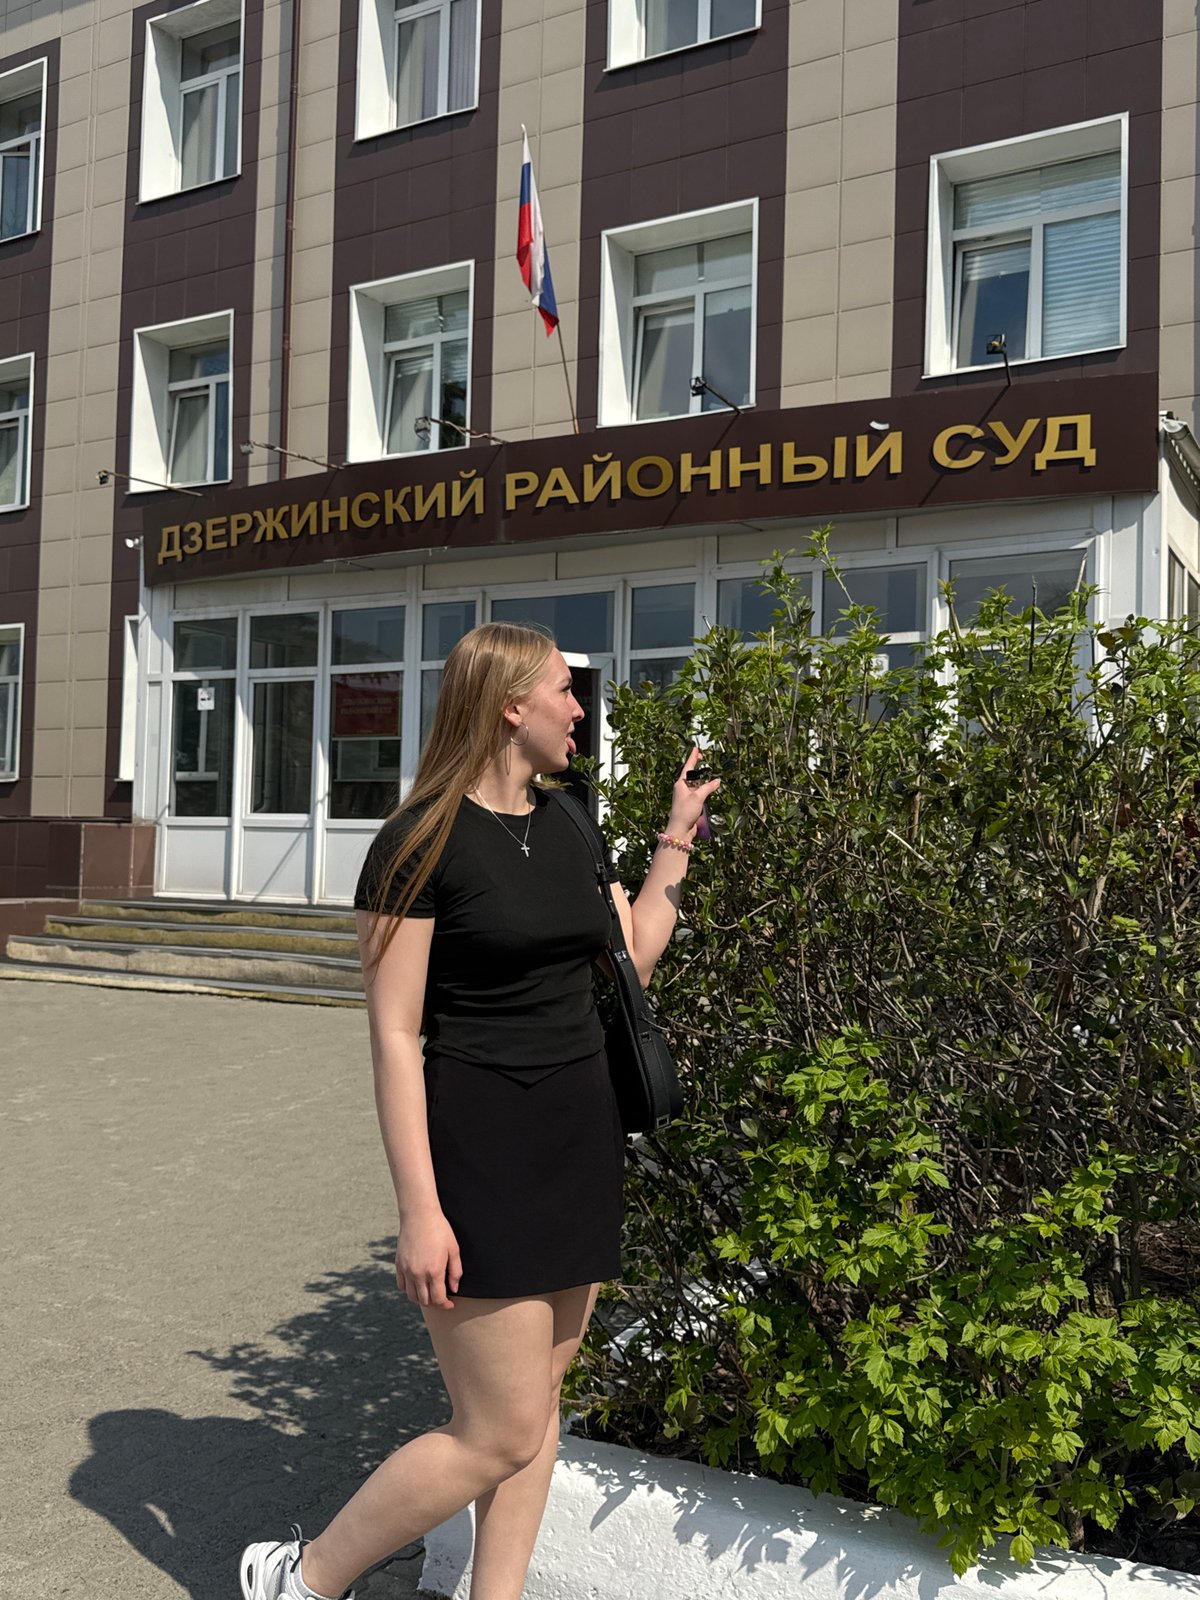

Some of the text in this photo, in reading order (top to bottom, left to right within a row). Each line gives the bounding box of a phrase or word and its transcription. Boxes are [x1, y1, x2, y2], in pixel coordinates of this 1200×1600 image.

[157, 413, 1097, 564] ДЗЕРЖИНСКИЙ РАЙОННЫЙ СУД
